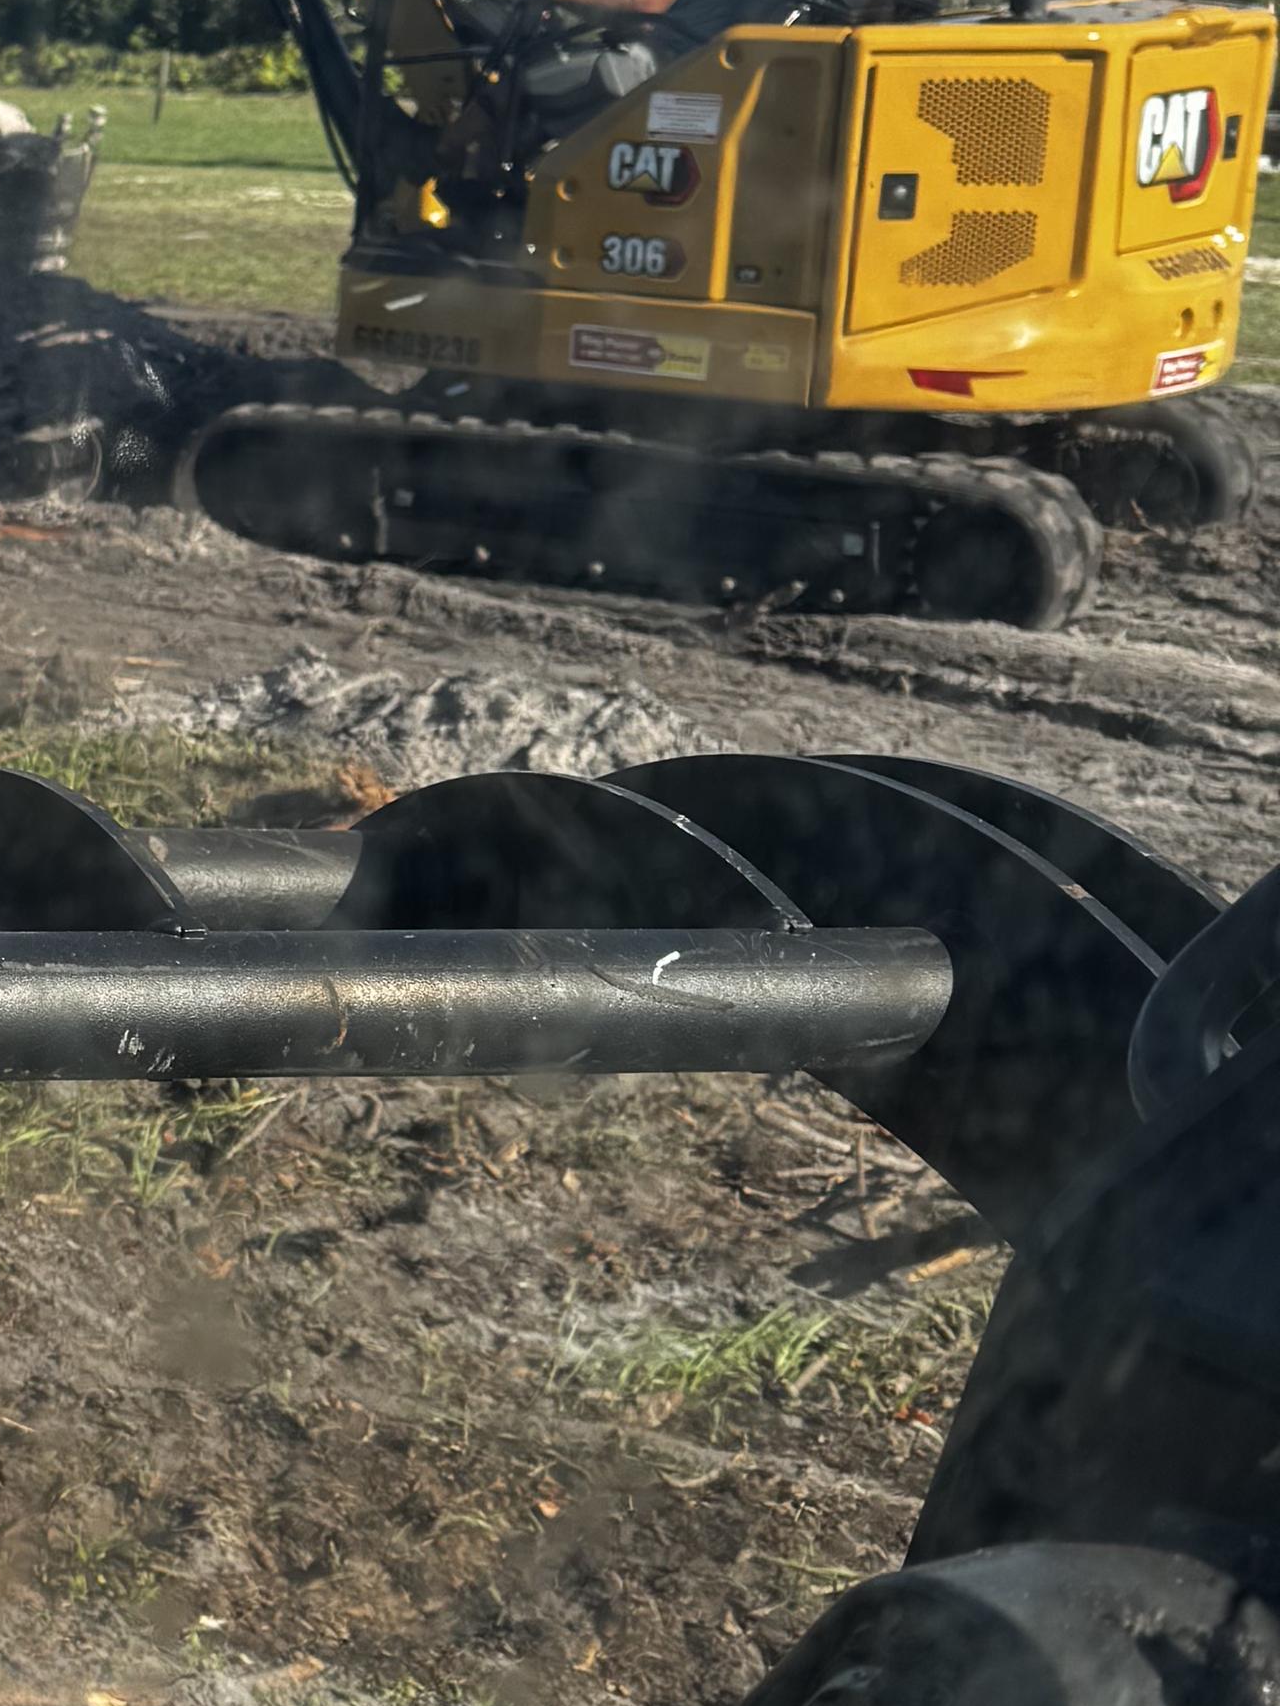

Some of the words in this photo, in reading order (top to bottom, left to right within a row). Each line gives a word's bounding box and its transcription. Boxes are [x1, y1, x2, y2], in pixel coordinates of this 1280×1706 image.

[1138, 89, 1209, 184] CAT
[609, 142, 681, 192] CAT
[601, 235, 666, 275] 306
